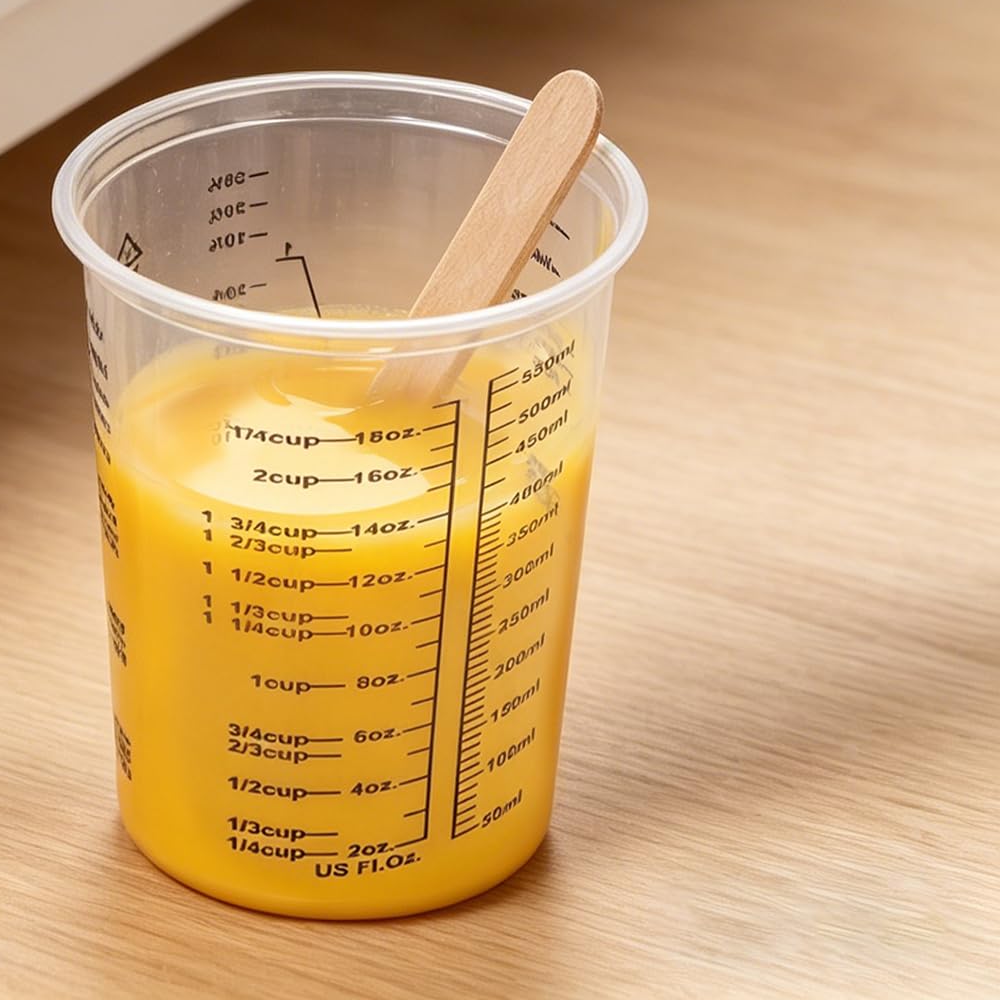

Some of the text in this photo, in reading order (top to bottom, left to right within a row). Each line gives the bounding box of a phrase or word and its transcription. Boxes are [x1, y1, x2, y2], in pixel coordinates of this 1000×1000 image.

[518, 379, 571, 424] 500ml
[515, 409, 568, 454] 450ml
[253, 467, 418, 489] 2cup 16oz.
[509, 460, 563, 505] 400ml
[202, 510, 415, 541] 1 3/4cup 14oz.
[506, 502, 559, 548] 350ml
[203, 529, 317, 559] 1 2/3cup
[202, 561, 413, 592] 1 1/2cup 12oz.
[502, 542, 554, 589] 300ml
[203, 595, 313, 625] 1 1/3cup
[498, 588, 550, 635] 250ml
[203, 611, 409, 642] 1 1/4cup 10oz.
[493, 632, 546, 680] 200ml
[356, 674, 405, 689] 8oz.
[228, 723, 401, 748] 3/4cup 6oz.
[487, 727, 536, 773] 100ml
[228, 739, 309, 764] 2/3cup
[227, 776, 397, 801] 1/2cup 4oz.
[481, 789, 523, 829] 50ml
[227, 816, 307, 842] 1/3cup
[227, 836, 395, 861] 1/4cup 2oz.
[314, 862, 349, 878] US
